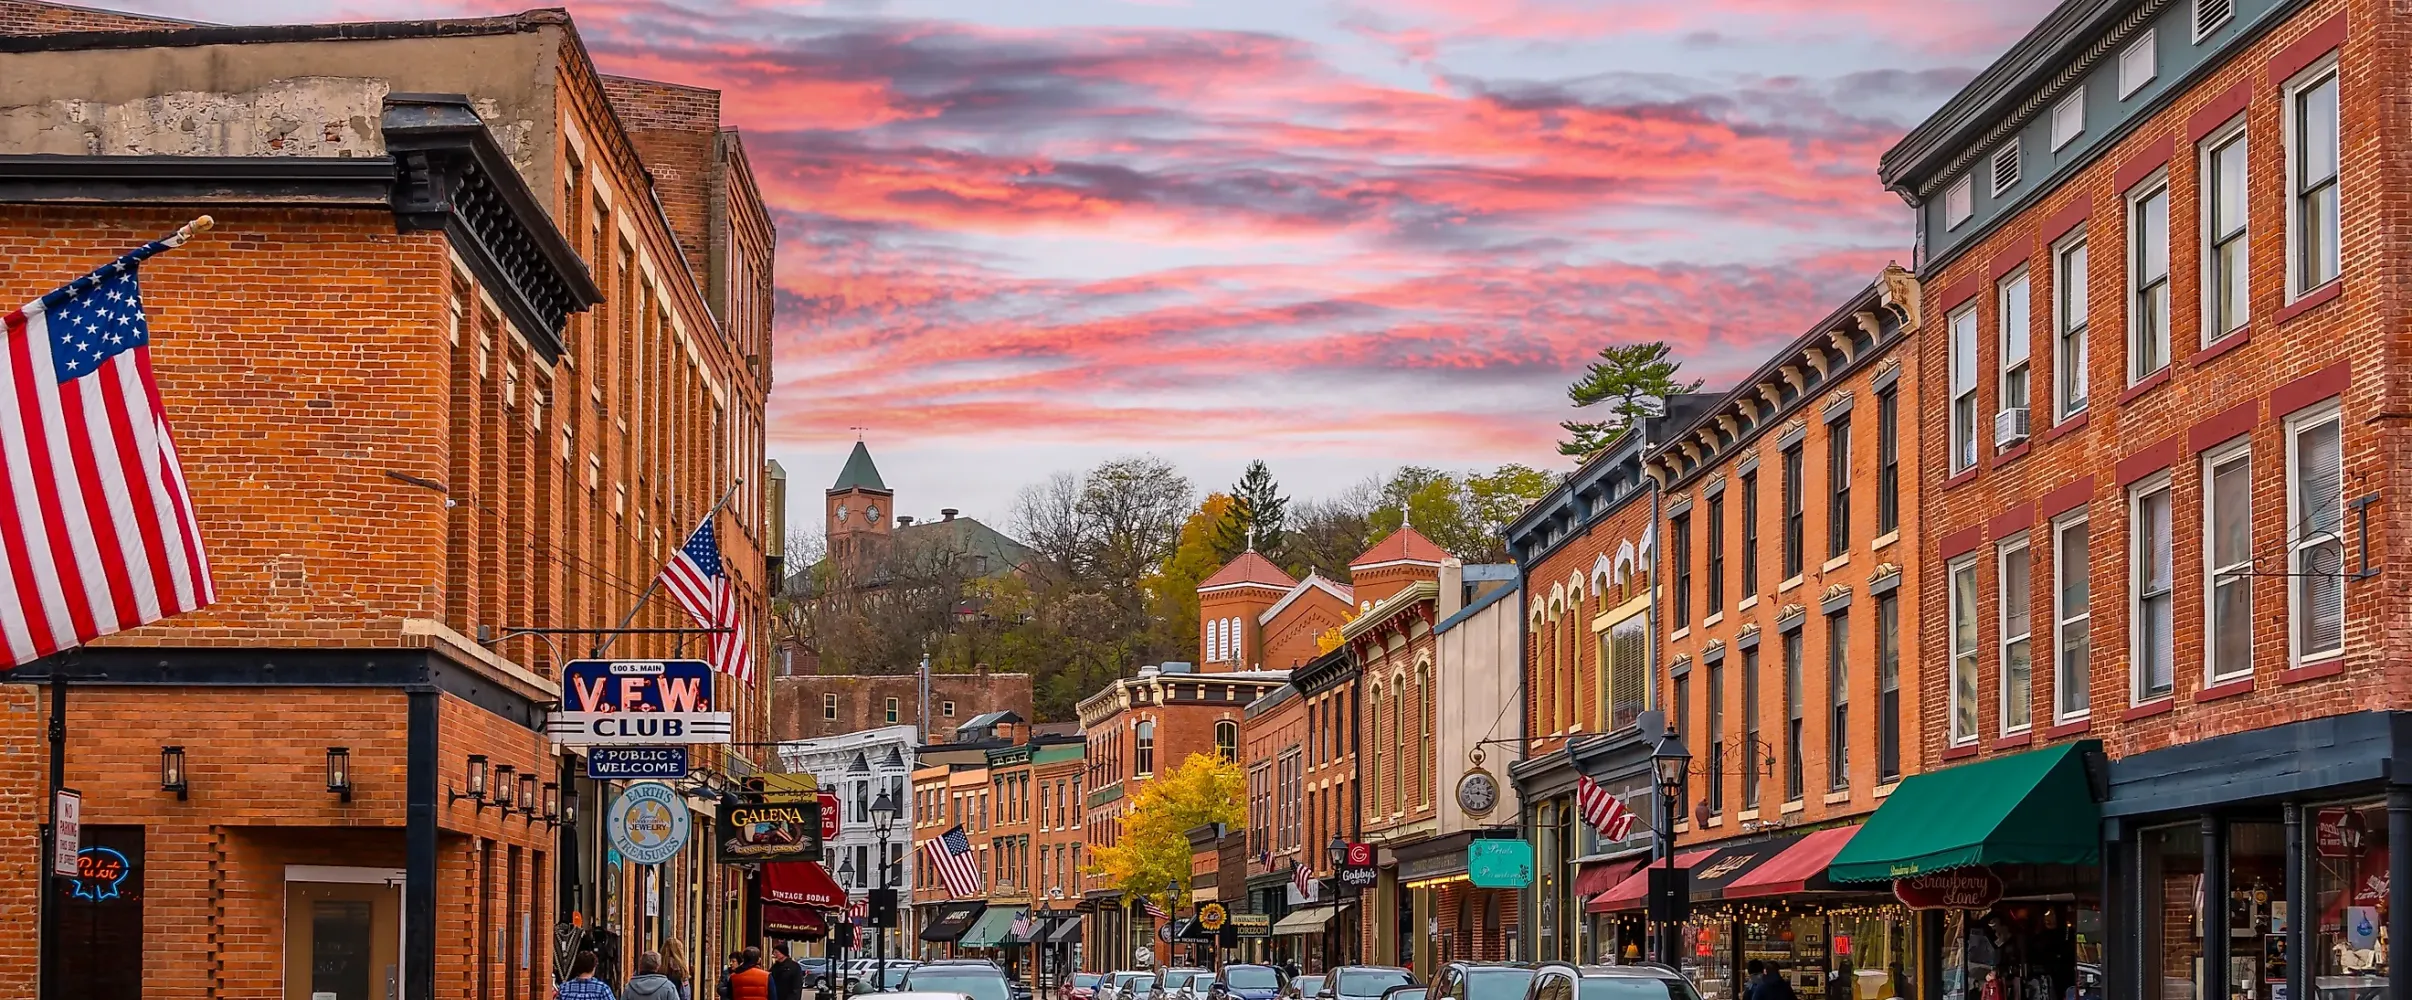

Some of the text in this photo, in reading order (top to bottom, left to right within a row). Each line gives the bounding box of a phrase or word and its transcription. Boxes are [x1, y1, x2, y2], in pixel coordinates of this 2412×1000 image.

[612, 664, 662, 672] 100 S. MAIN
[573, 676, 709, 713] V.F.W.
[592, 718, 684, 737] CLUB
[607, 750, 668, 761] PUBLIC
[596, 762, 679, 773] WELCOME
[626, 786, 674, 804] EARTH'S
[64, 803, 73, 818] NO
[731, 807, 805, 828] GALENA
[60, 820, 77, 838] PARKING
[628, 823, 667, 831] JEWELRY
[617, 835, 680, 861] TREASURES
[1351, 846, 1367, 863] G
[78, 856, 121, 880] Pabst
[1342, 867, 1377, 885] Gabby's
[1911, 869, 1988, 898] Strawberry
[772, 889, 830, 903] VINTAGE SODAS
[1943, 886, 1981, 905] Lane
